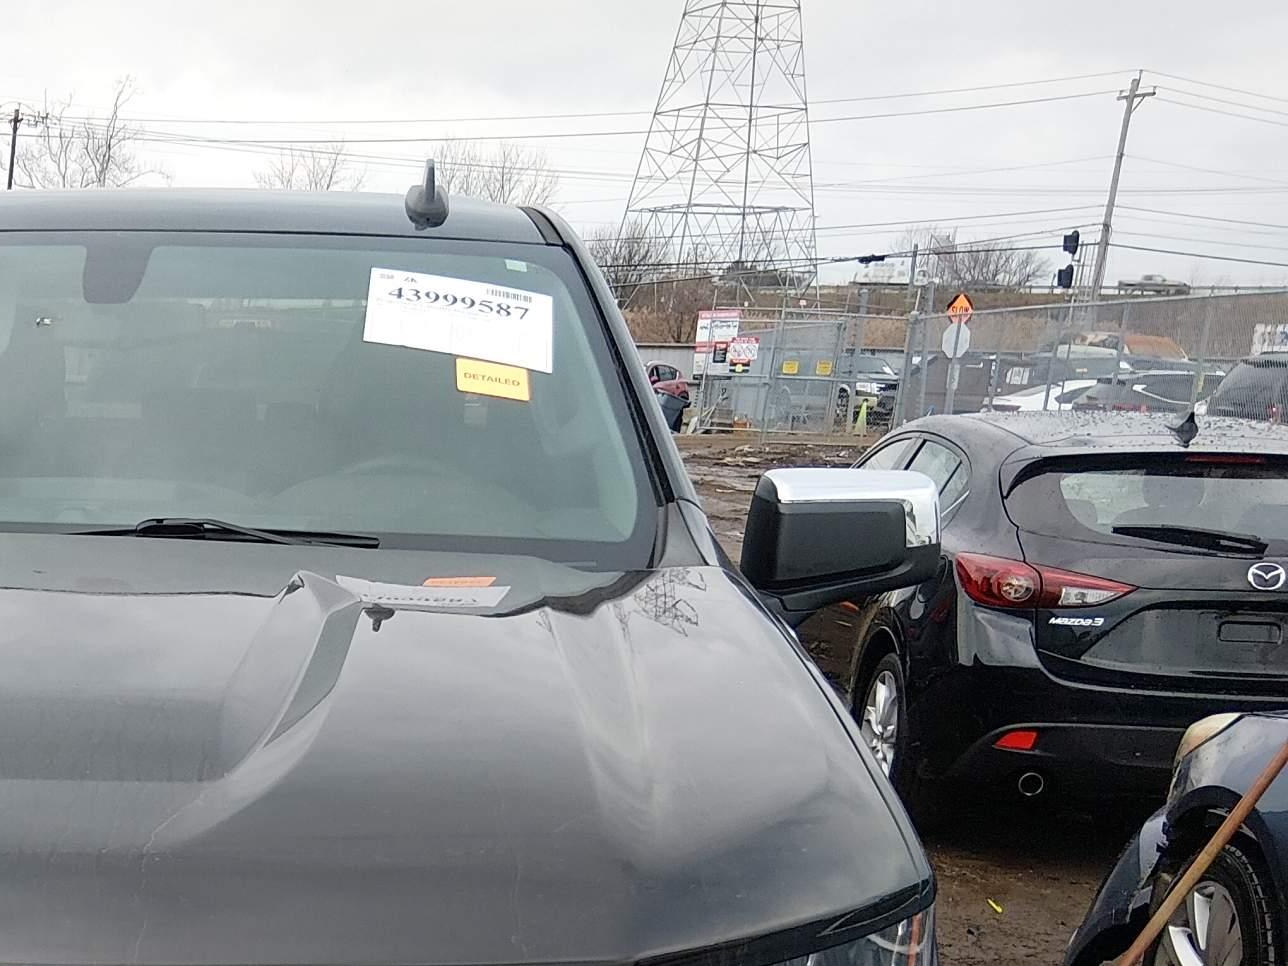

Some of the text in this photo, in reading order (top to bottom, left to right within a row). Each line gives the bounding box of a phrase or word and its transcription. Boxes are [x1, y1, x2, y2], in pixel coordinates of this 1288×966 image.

[387, 287, 530, 320] 43999587
[951, 305, 970, 314] SLOW
[463, 371, 521, 387] DETAILED
